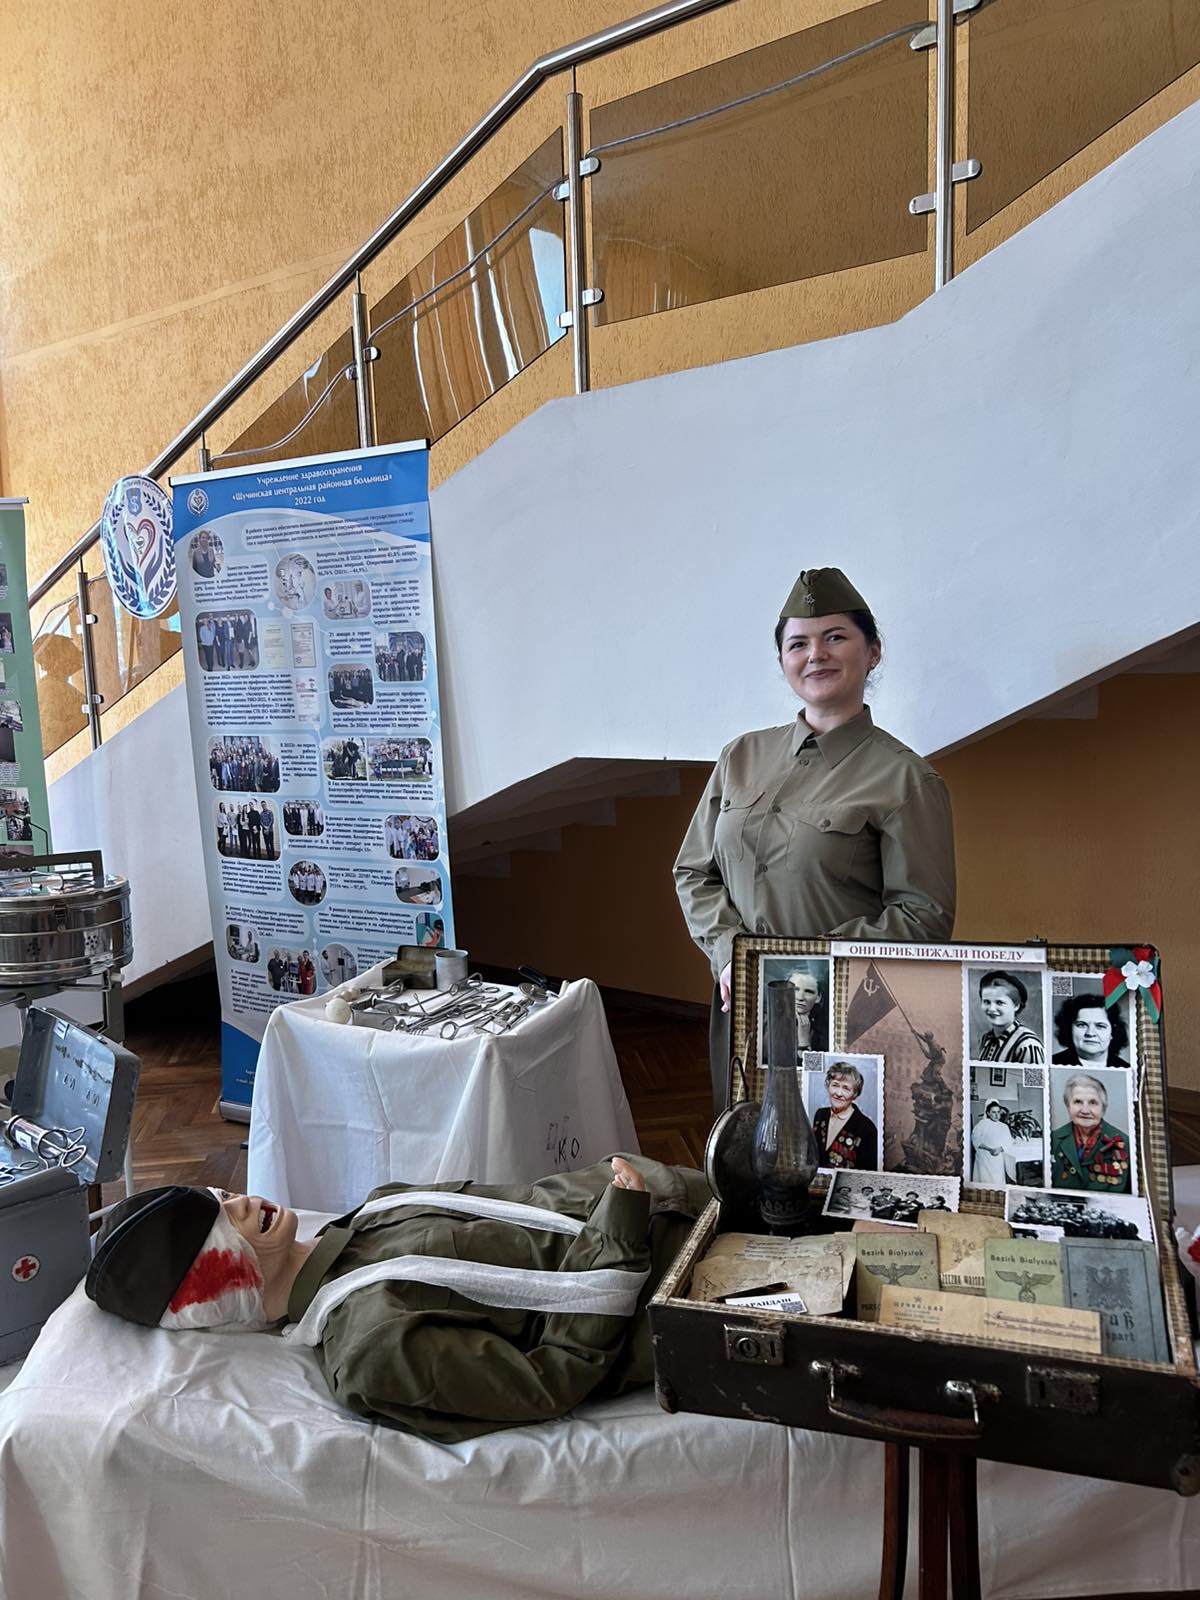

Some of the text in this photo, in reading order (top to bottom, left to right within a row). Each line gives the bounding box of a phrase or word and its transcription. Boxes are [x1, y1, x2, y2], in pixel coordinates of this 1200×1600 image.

[256, 464, 362, 486] Учреждение здравоохранения
[232, 474, 392, 502] «Щучинская центральная районная больница»
[294, 496, 326, 505] 2022 год
[849, 945, 1025, 961] ОНИ ПРИБЛИЖАЛИ ПОБЕДУ
[990, 1254, 1016, 1263] Bezirk
